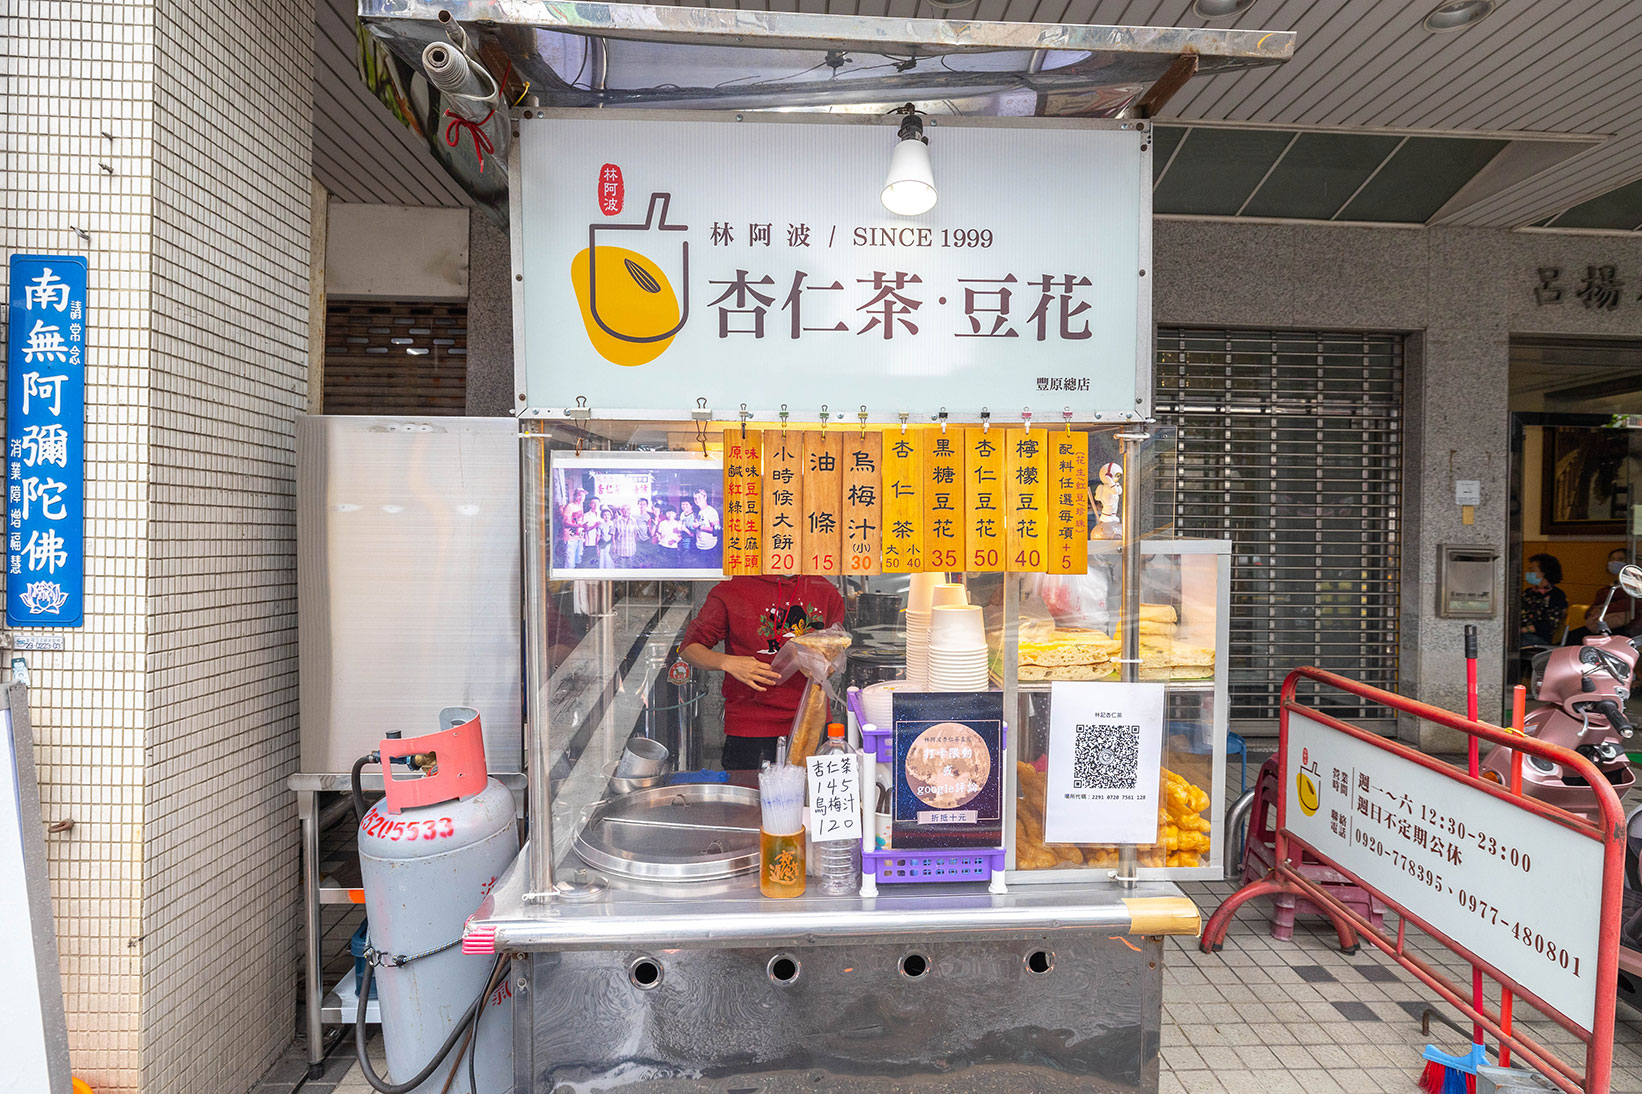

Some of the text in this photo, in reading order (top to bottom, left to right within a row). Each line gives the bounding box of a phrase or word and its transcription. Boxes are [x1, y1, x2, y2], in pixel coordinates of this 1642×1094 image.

[603, 168, 618, 212] 林阿波
[710, 222, 813, 248] 林阿波
[853, 226, 933, 248] SINCE
[940, 228, 994, 249] 1999
[69, 300, 82, 365] 請常念
[1036, 377, 1090, 391] 豐原總店
[21, 267, 71, 575] 南無阿彌陀佛
[728, 446, 759, 460] 原味
[728, 482, 759, 496] 紅豆
[772, 446, 795, 550] 小時候大餅
[808, 451, 837, 534] 油條
[848, 450, 876, 540] 烏梅汁
[891, 440, 915, 539] 杏仁茶
[932, 439, 956, 539] 黑糖豆花
[974, 439, 997, 539] 杏仁豆花
[1015, 439, 1039, 539] 檸檬豆花
[728, 518, 759, 533] 花生
[728, 537, 759, 551] 芝麻
[852, 543, 871, 554] (小)
[885, 544, 921, 555] 大 小
[728, 555, 759, 569] 芋頭
[771, 554, 794, 570] 20
[812, 554, 834, 570] 15
[851, 555, 872, 570] 30
[885, 558, 921, 568] 50 40
[931, 549, 957, 567] 35
[974, 549, 998, 567] 50
[1015, 549, 1040, 567] 40
[812, 757, 851, 777] 杏仁茶
[817, 779, 853, 795] 145
[814, 794, 855, 816] 烏梅汁
[819, 819, 854, 836] 120
[1356, 795, 1463, 866] 週日不定期公休
[1420, 803, 1532, 873] 12:30-23:00
